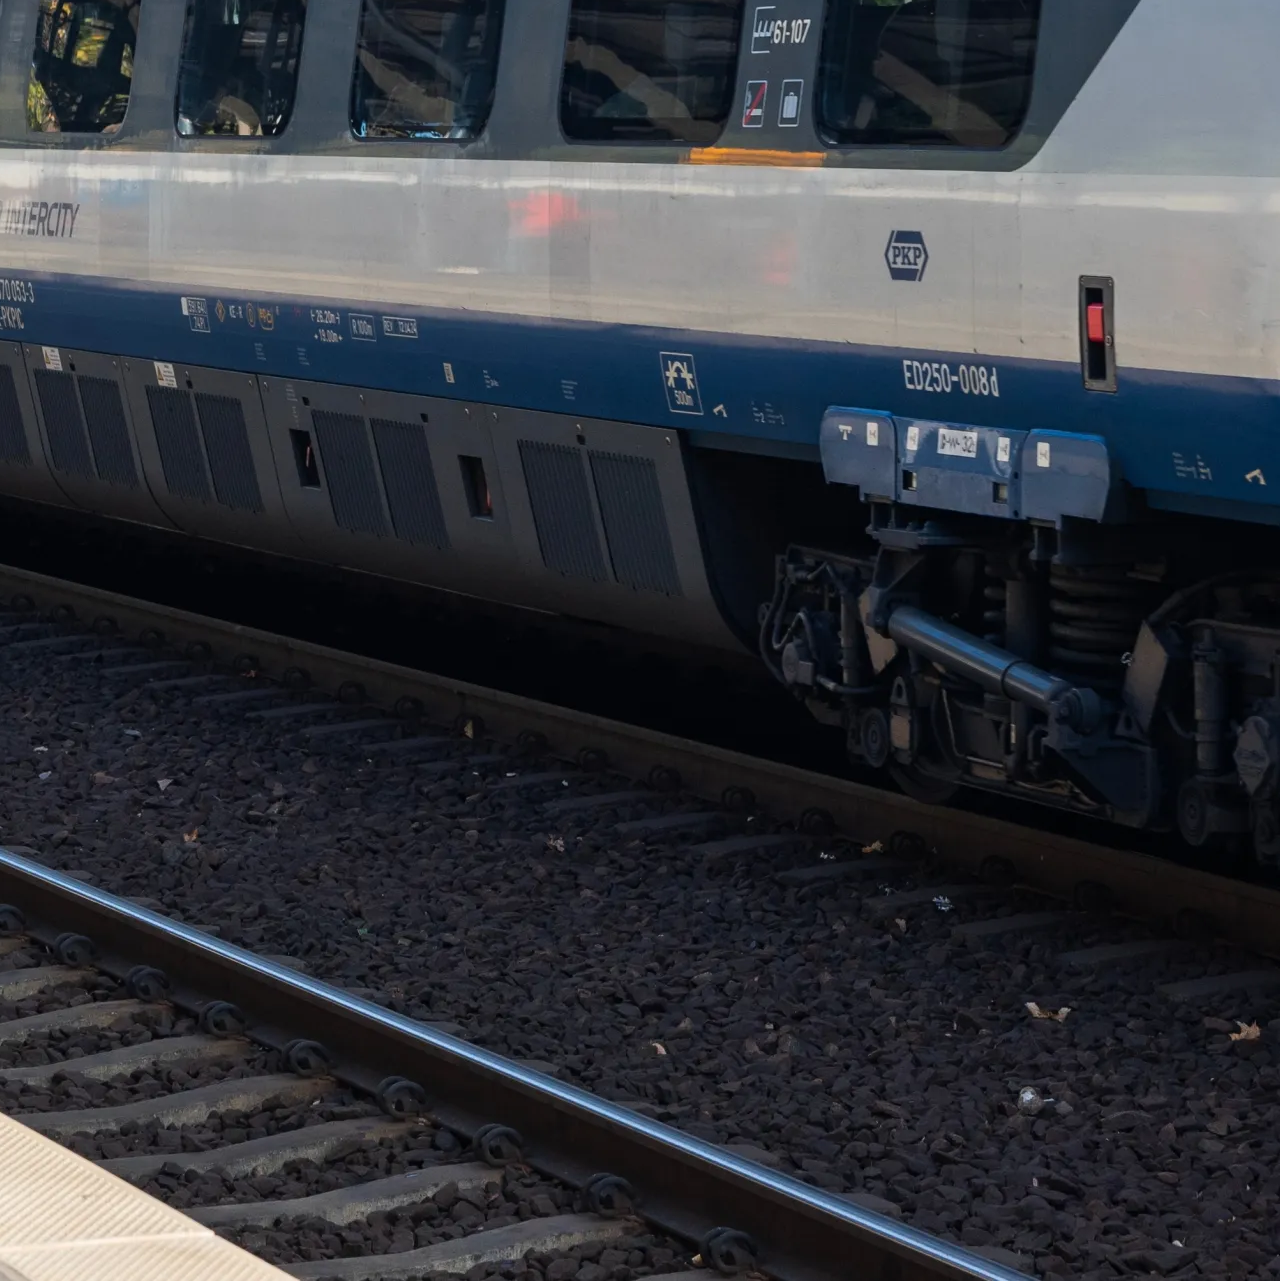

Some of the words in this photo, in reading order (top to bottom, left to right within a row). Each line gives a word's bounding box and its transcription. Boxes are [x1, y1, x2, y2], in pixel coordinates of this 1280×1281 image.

[773, 19, 811, 44] 61-107
[5, 201, 81, 238] INTERCITY
[892, 245, 922, 267] PKP
[902, 359, 1000, 398] ED250-008d
